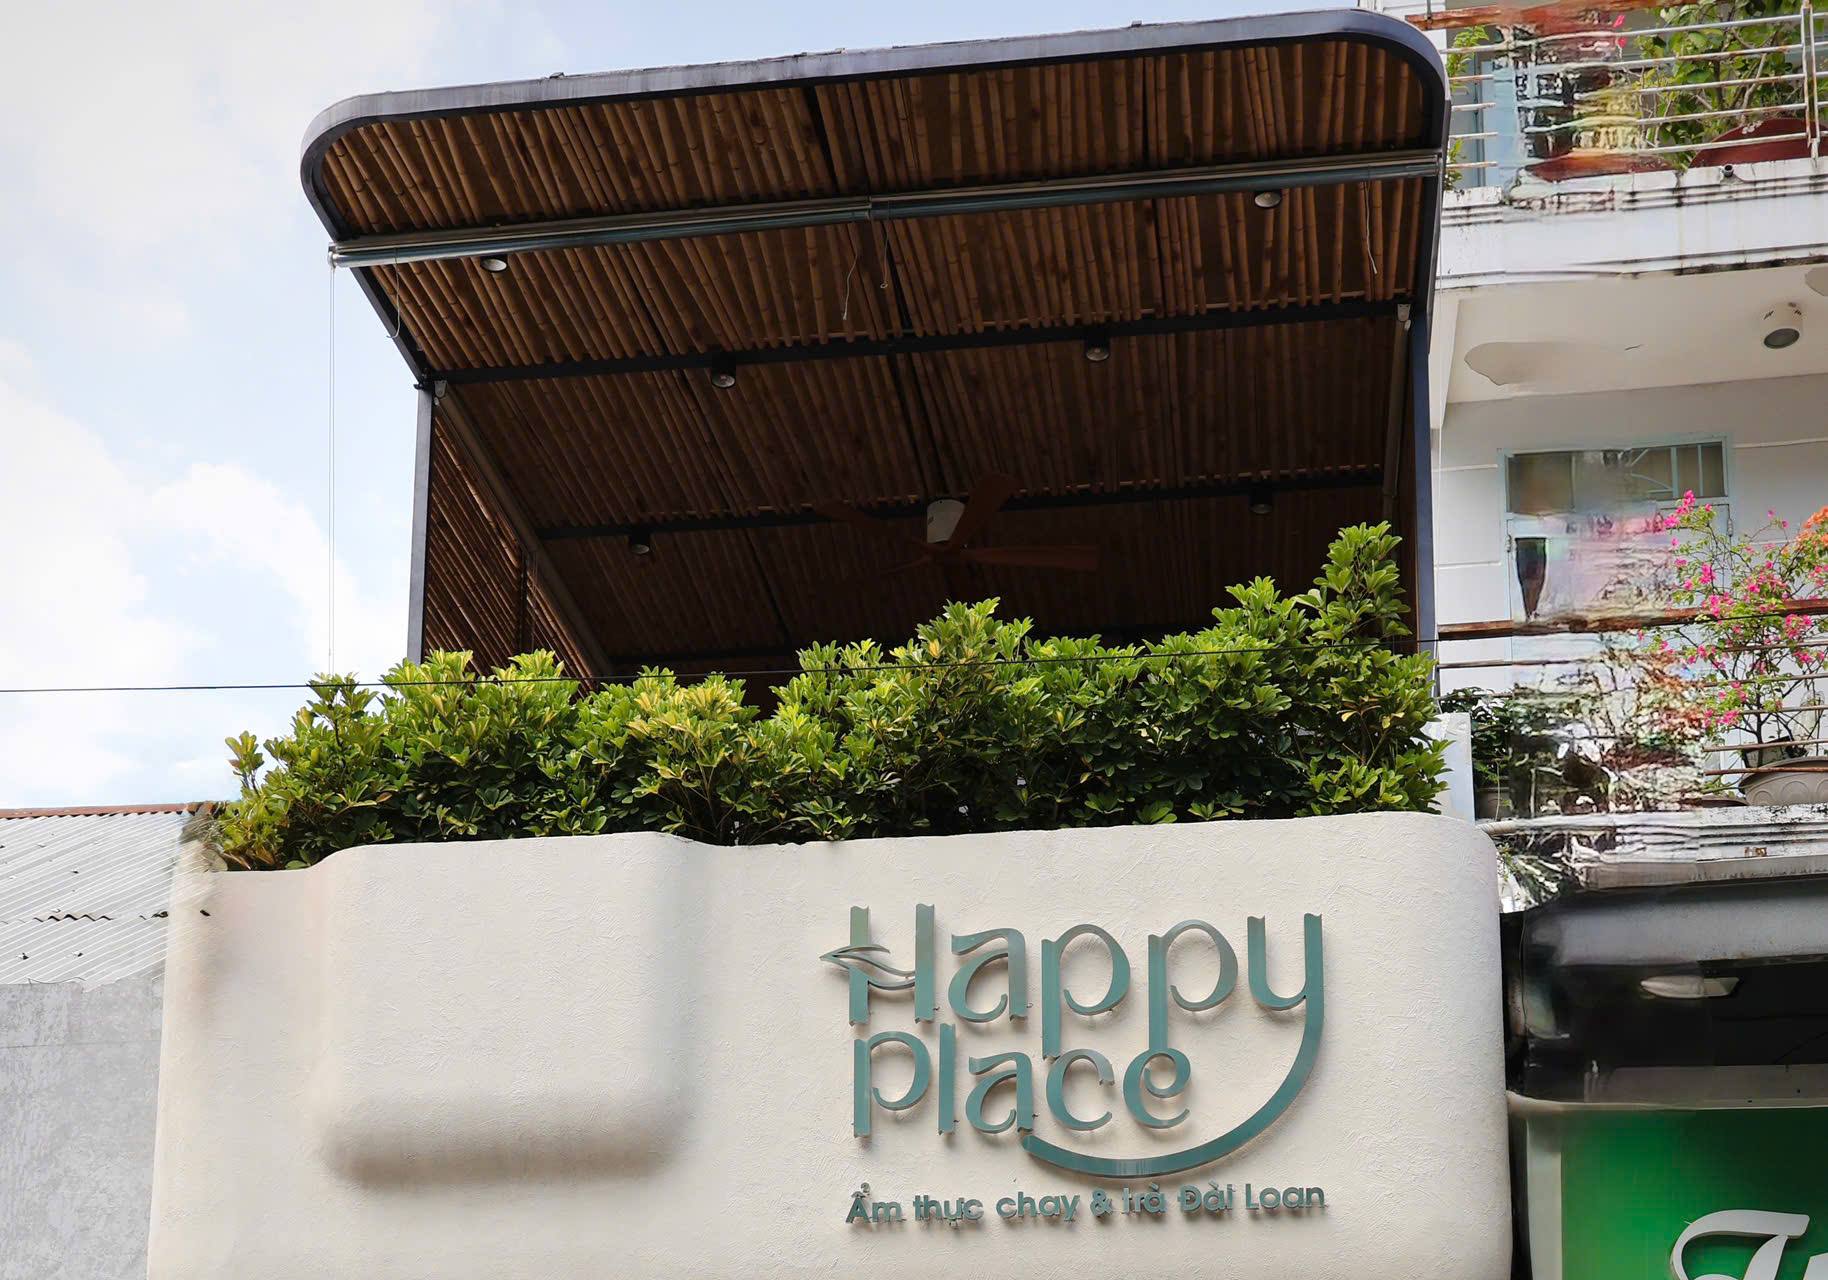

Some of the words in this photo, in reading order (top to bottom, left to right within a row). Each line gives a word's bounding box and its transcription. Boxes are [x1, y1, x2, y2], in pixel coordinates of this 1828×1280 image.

[845, 1182, 902, 1224] Ẩm
[912, 1193, 984, 1228] thực
[996, 1189, 1081, 1222] chay
[1090, 1190, 1113, 1215] &
[1122, 1183, 1167, 1214] trà
[1177, 1180, 1234, 1212] Đài
[1245, 1182, 1325, 1211] Loan
